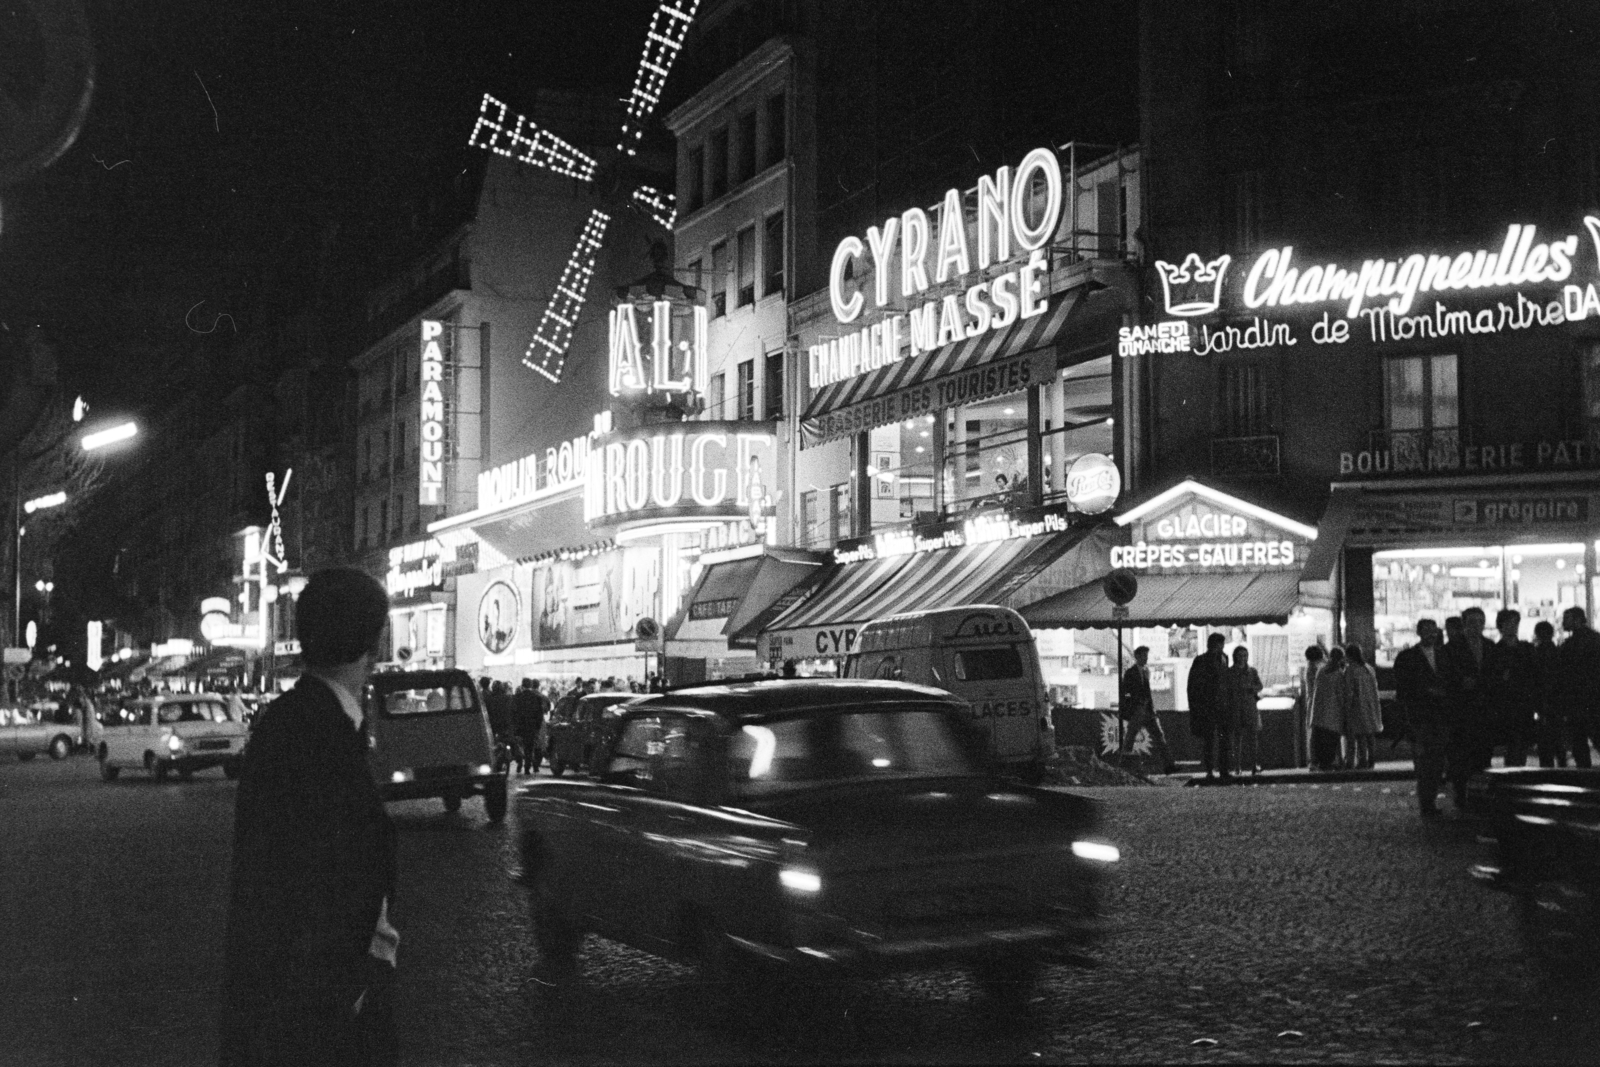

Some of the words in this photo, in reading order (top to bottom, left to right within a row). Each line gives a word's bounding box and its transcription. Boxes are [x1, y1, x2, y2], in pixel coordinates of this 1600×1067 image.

[829, 147, 1062, 324] CYRANO
[1243, 223, 1579, 319] Champigneulles
[809, 315, 903, 389] CHAMPAGNE
[909, 249, 1048, 357] MASSÉ
[1118, 320, 1189, 342] SAMEDI
[1311, 310, 1350, 344] de
[1359, 291, 1565, 343] Montmartre
[1118, 335, 1191, 357] DIMANCHE
[422, 320, 444, 502] PARAMOUNT
[901, 385, 932, 413] DES
[937, 358, 1032, 405] TOURISTES
[478, 453, 537, 508] MOULIN
[700, 519, 751, 550] TABAC
[915, 535, 944, 552] Super
[943, 529, 963, 547] Pils
[1011, 520, 1044, 539] Super
[1044, 513, 1067, 532] Pils
[1157, 513, 1248, 538] GLACIER
